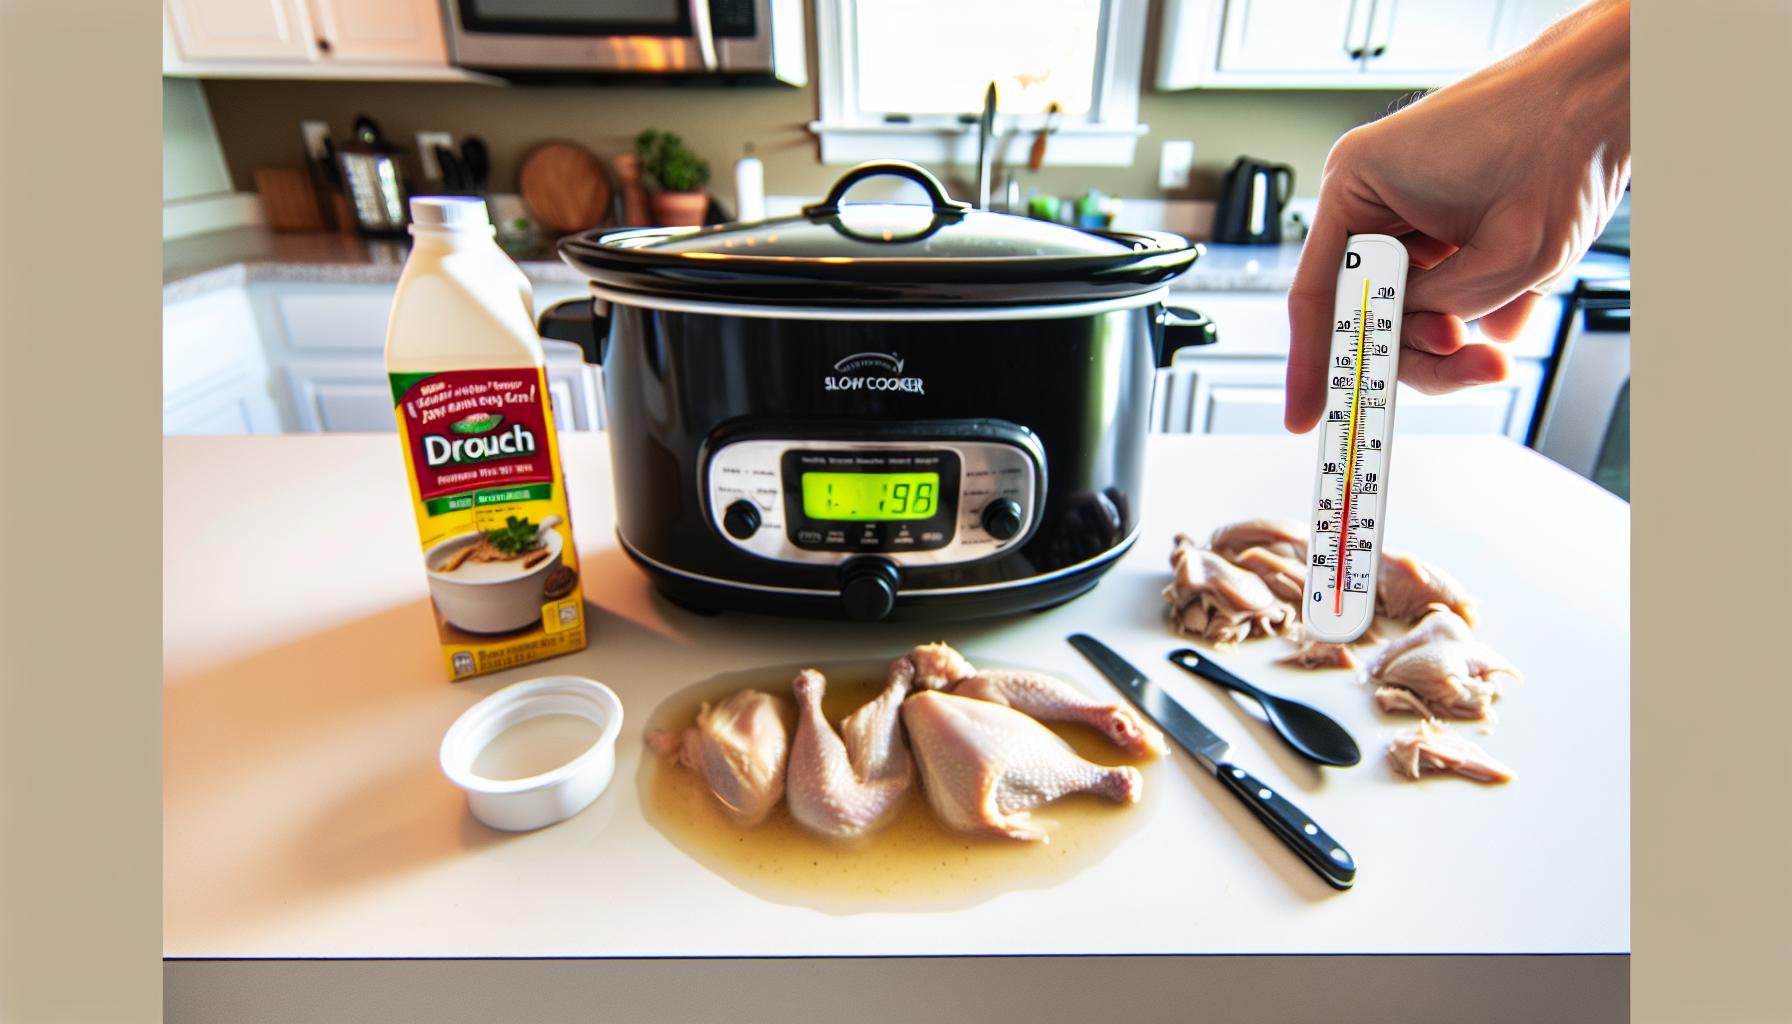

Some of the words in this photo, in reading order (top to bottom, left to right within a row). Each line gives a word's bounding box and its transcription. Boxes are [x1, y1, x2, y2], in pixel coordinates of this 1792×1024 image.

[1345, 251, 1361, 269] D
[824, 376, 864, 390] SLOW
[424, 424, 536, 466] Drouch
